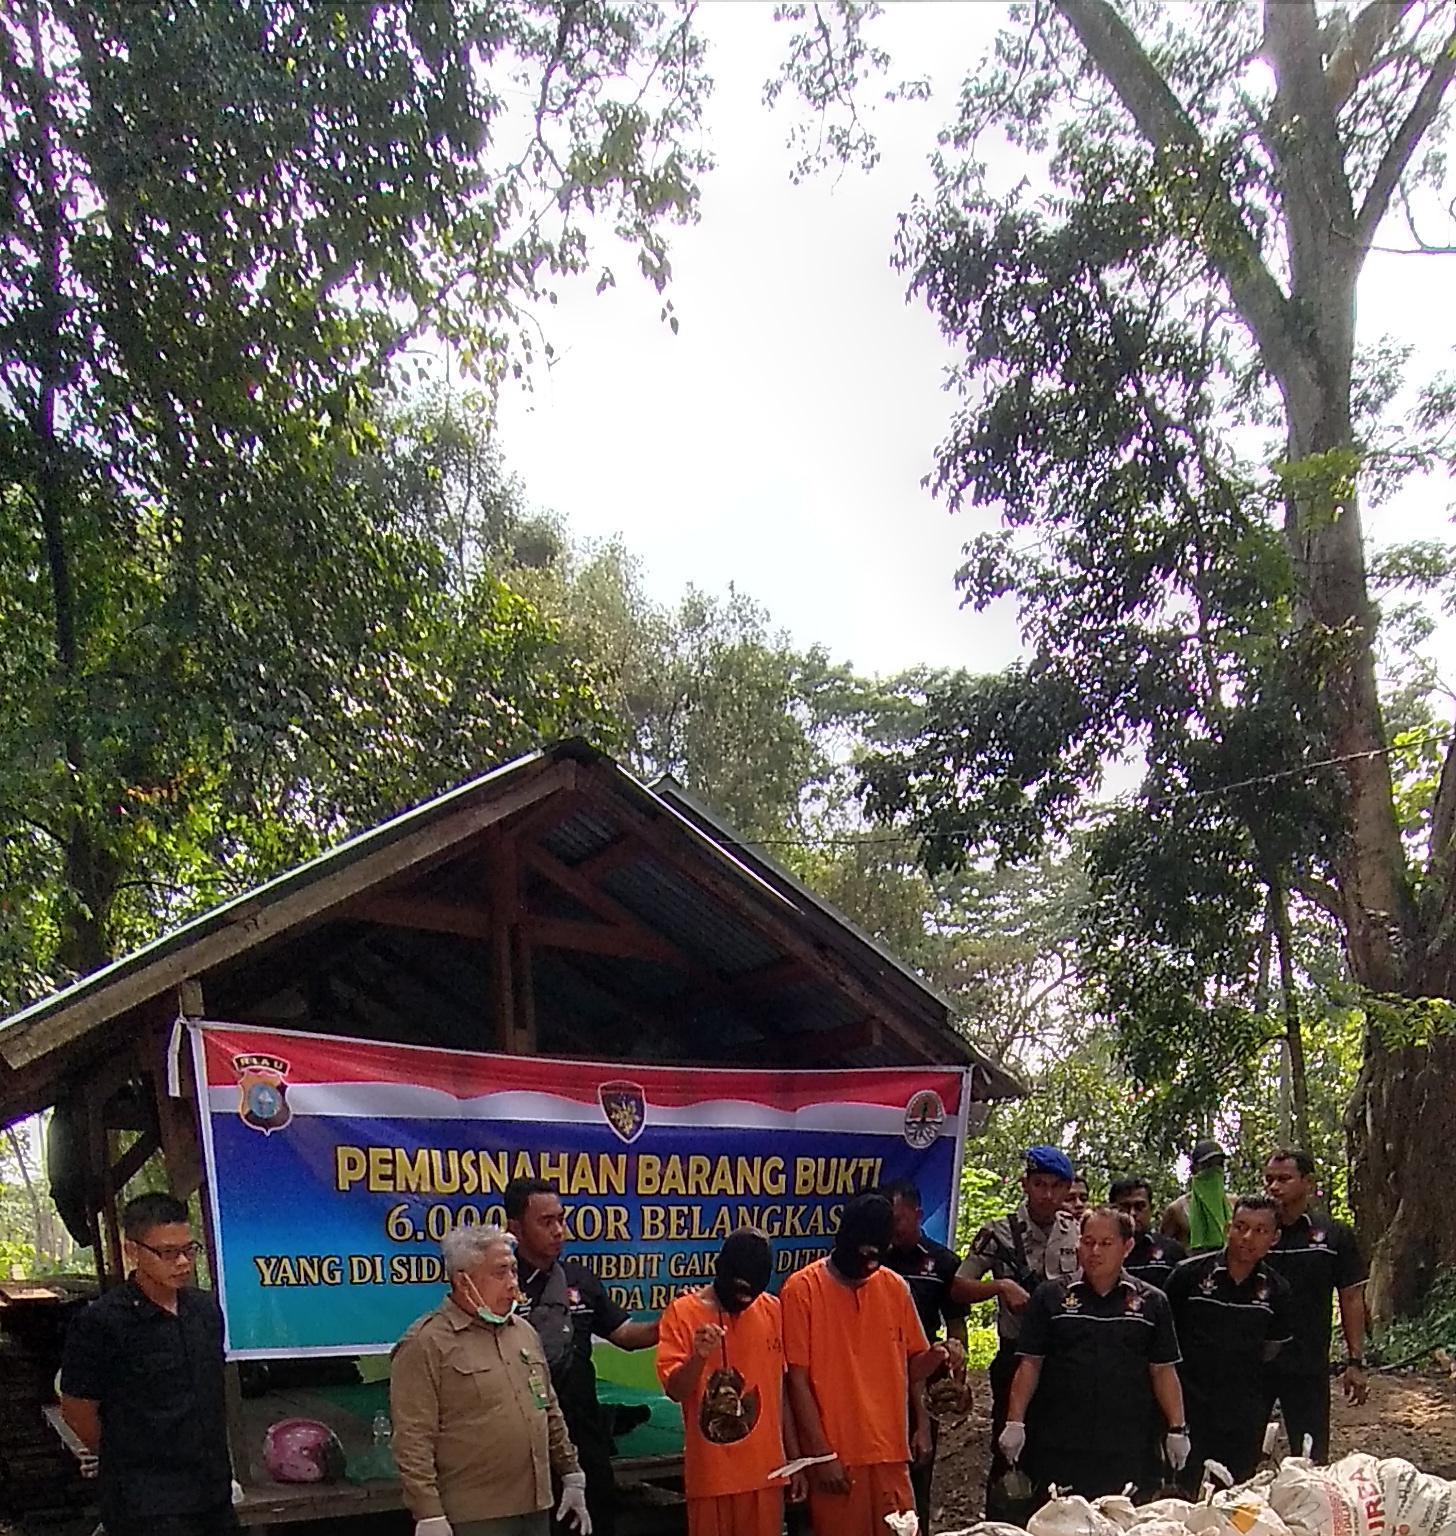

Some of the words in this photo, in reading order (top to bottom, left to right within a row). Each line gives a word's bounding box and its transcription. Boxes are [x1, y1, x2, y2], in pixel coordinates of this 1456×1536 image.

[240, 1057, 284, 1070] RIAU
[335, 1145, 628, 1195] PEMUSNAHAN
[637, 1156, 786, 1195] BARANG
[795, 1156, 883, 1195] BUKTI
[641, 1204, 845, 1241] BELANGKAS
[256, 1257, 342, 1286] YANG
[350, 1256, 384, 1283] DI
[670, 1251, 718, 1278] GAK
[607, 1285, 645, 1311] DA
